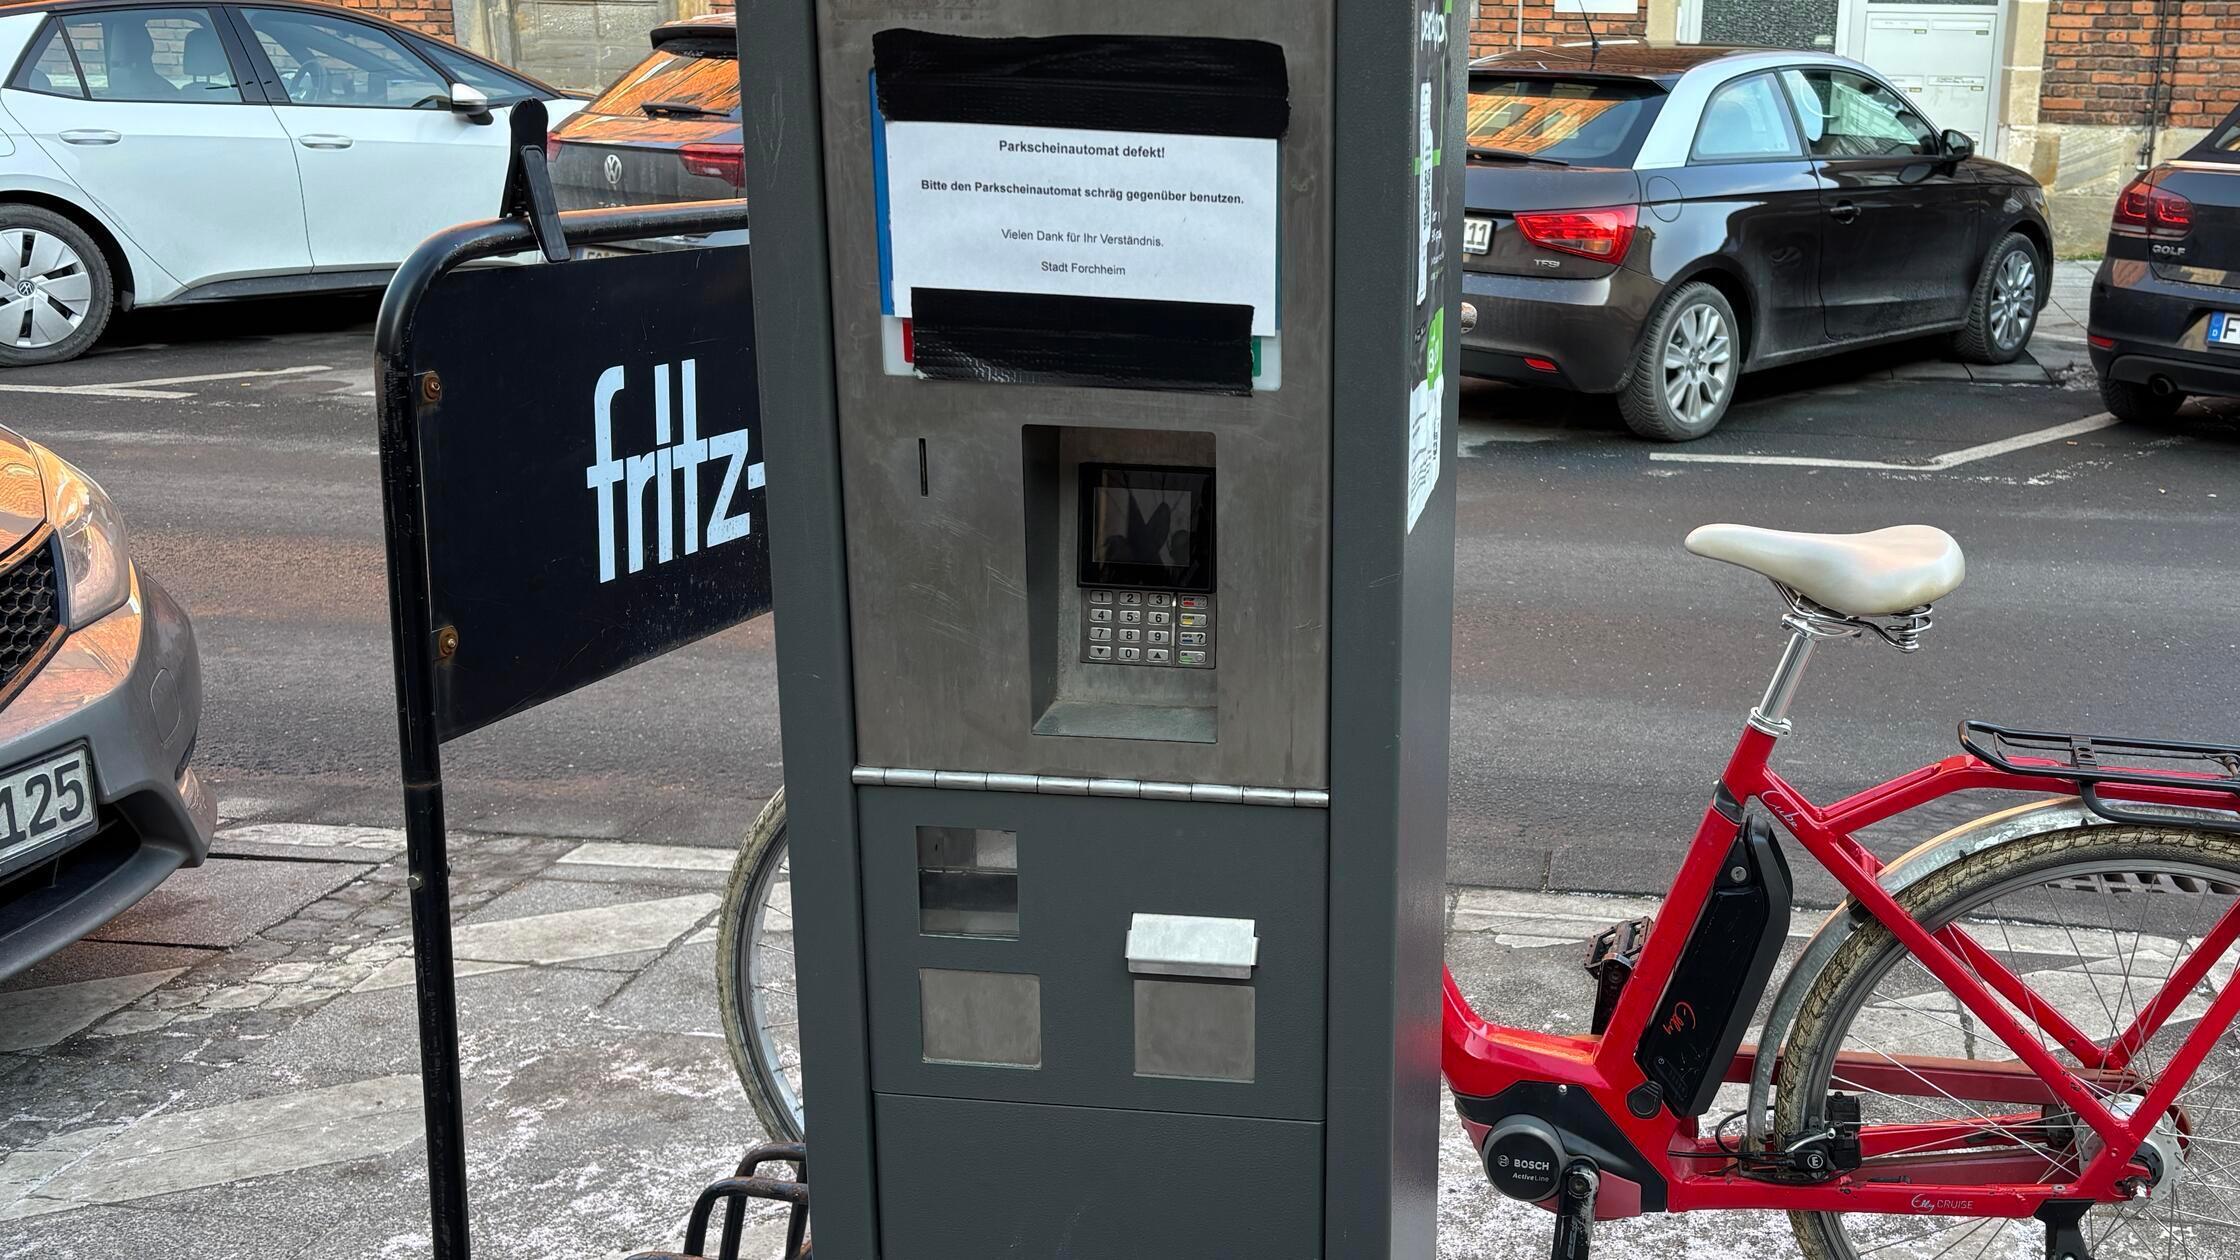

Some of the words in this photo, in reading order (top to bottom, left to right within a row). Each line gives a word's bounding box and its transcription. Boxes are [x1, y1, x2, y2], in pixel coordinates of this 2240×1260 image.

[999, 140, 1119, 156] Parkscheinautomat
[1122, 146, 1165, 158] defekt!
[921, 180, 947, 191] Bitte
[950, 181, 971, 191] den
[975, 182, 1082, 197] Parkscheinautomat
[1084, 188, 1123, 201] schräg
[1126, 190, 1187, 202] gegenüber
[1190, 191, 1244, 204] benutzen.
[1001, 229, 1033, 240] Vielen
[1037, 230, 1063, 242] Dank
[1067, 232, 1080, 243] für
[1083, 233, 1097, 244] Ihr
[1100, 233, 1164, 247] Verständnis.
[1464, 221, 1486, 247] 11
[2152, 244, 2186, 255] GOLF
[1041, 261, 1068, 273] Stadt
[1071, 262, 1126, 275] Forchheim
[1534, 259, 1560, 268] TFSI
[1099, 592, 1104, 601] 1
[1127, 593, 1134, 603] 2
[1156, 595, 1163, 604] 3
[1098, 610, 1105, 620] 4
[1126, 612, 1133, 621] 5
[1155, 614, 1162, 623] 6
[1097, 629, 1104, 638] 7
[1126, 631, 1133, 640] 8
[1154, 632, 1161, 641] 9
[1125, 649, 1132, 657] 0
[0, 760, 84, 849] 125
[1513, 1159, 1550, 1171] BOSCH
[1936, 1199, 1974, 1209] CRUISE
